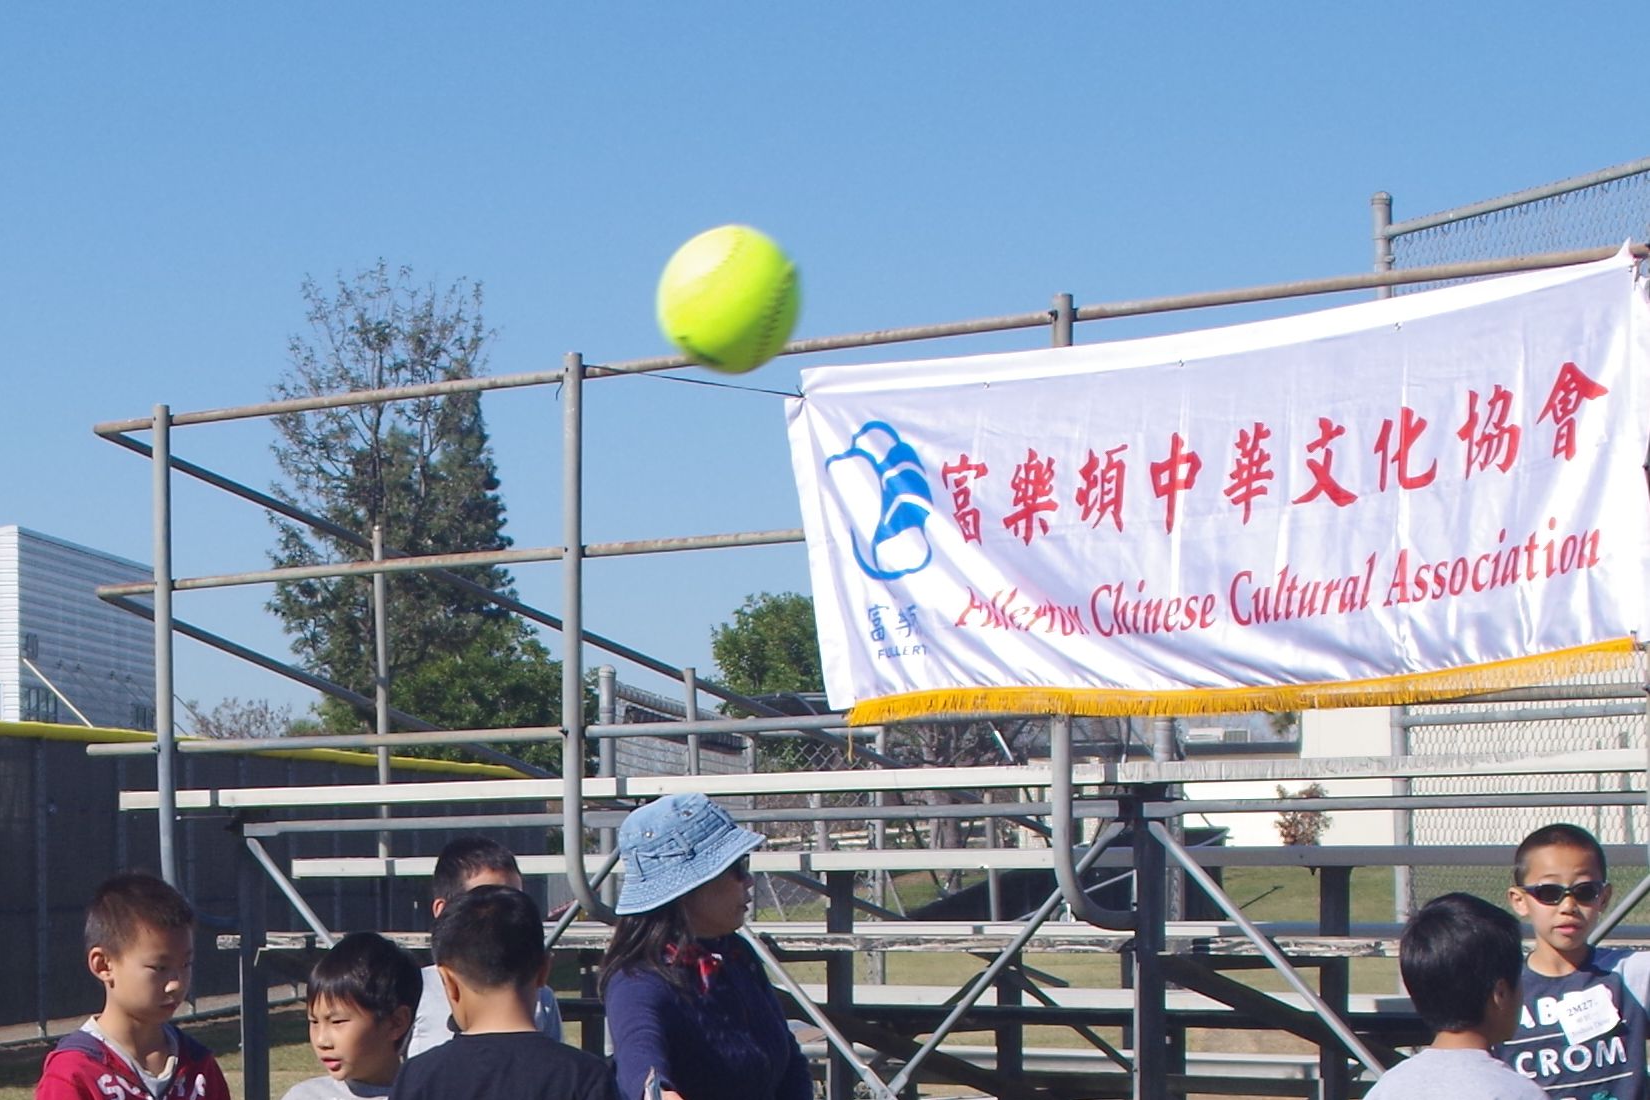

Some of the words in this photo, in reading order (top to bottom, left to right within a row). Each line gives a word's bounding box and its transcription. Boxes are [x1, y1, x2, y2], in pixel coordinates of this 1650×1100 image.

[942, 362, 1609, 546] 富樂頓中華文化協會
[955, 586, 1090, 636] Fullerton
[1090, 579, 1217, 637] Chinese
[1230, 551, 1377, 626] Cultural
[1383, 516, 1601, 607] Association
[1515, 1036, 1627, 1079] CROM
